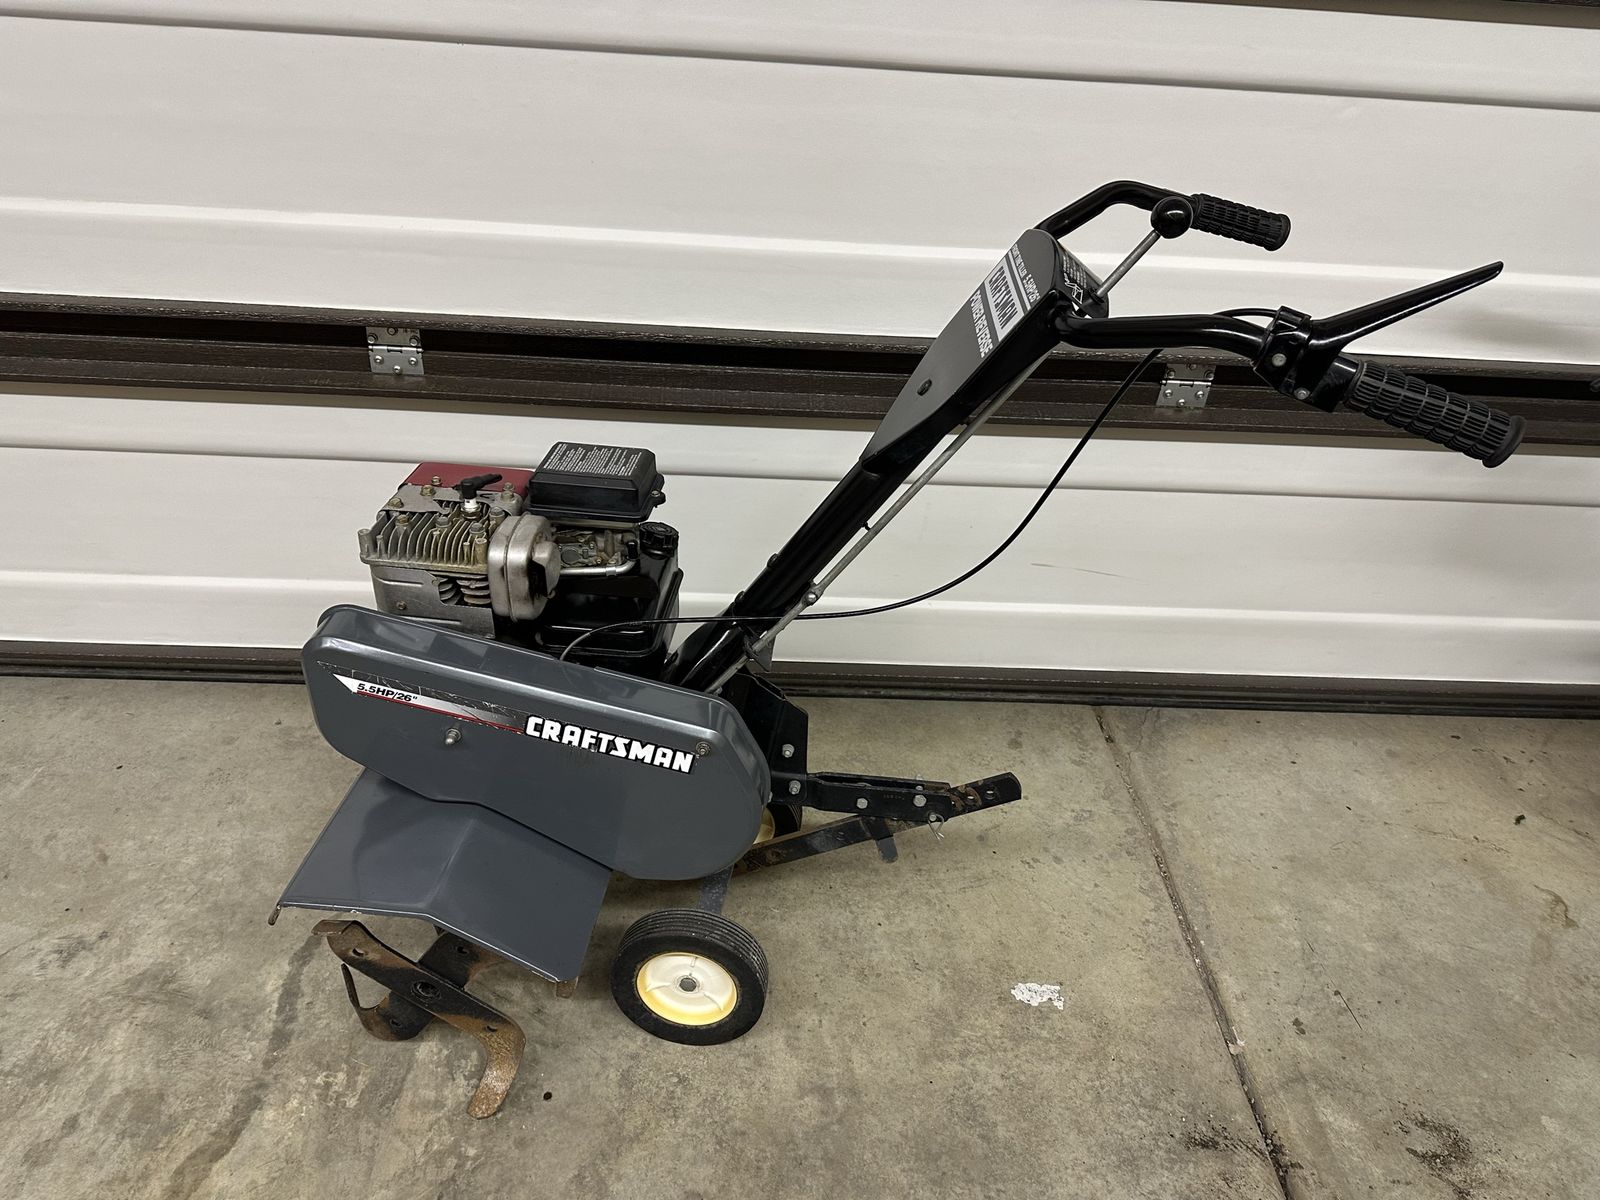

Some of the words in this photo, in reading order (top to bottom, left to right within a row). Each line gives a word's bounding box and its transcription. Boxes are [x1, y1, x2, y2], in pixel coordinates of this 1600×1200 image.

[970, 288, 985, 322] POWER
[988, 265, 1018, 330] CRAFTSMAN
[974, 313, 993, 358] REVERSE
[357, 682, 418, 702] 5.5HP/26"
[525, 715, 694, 773] CRAFTSMAN
